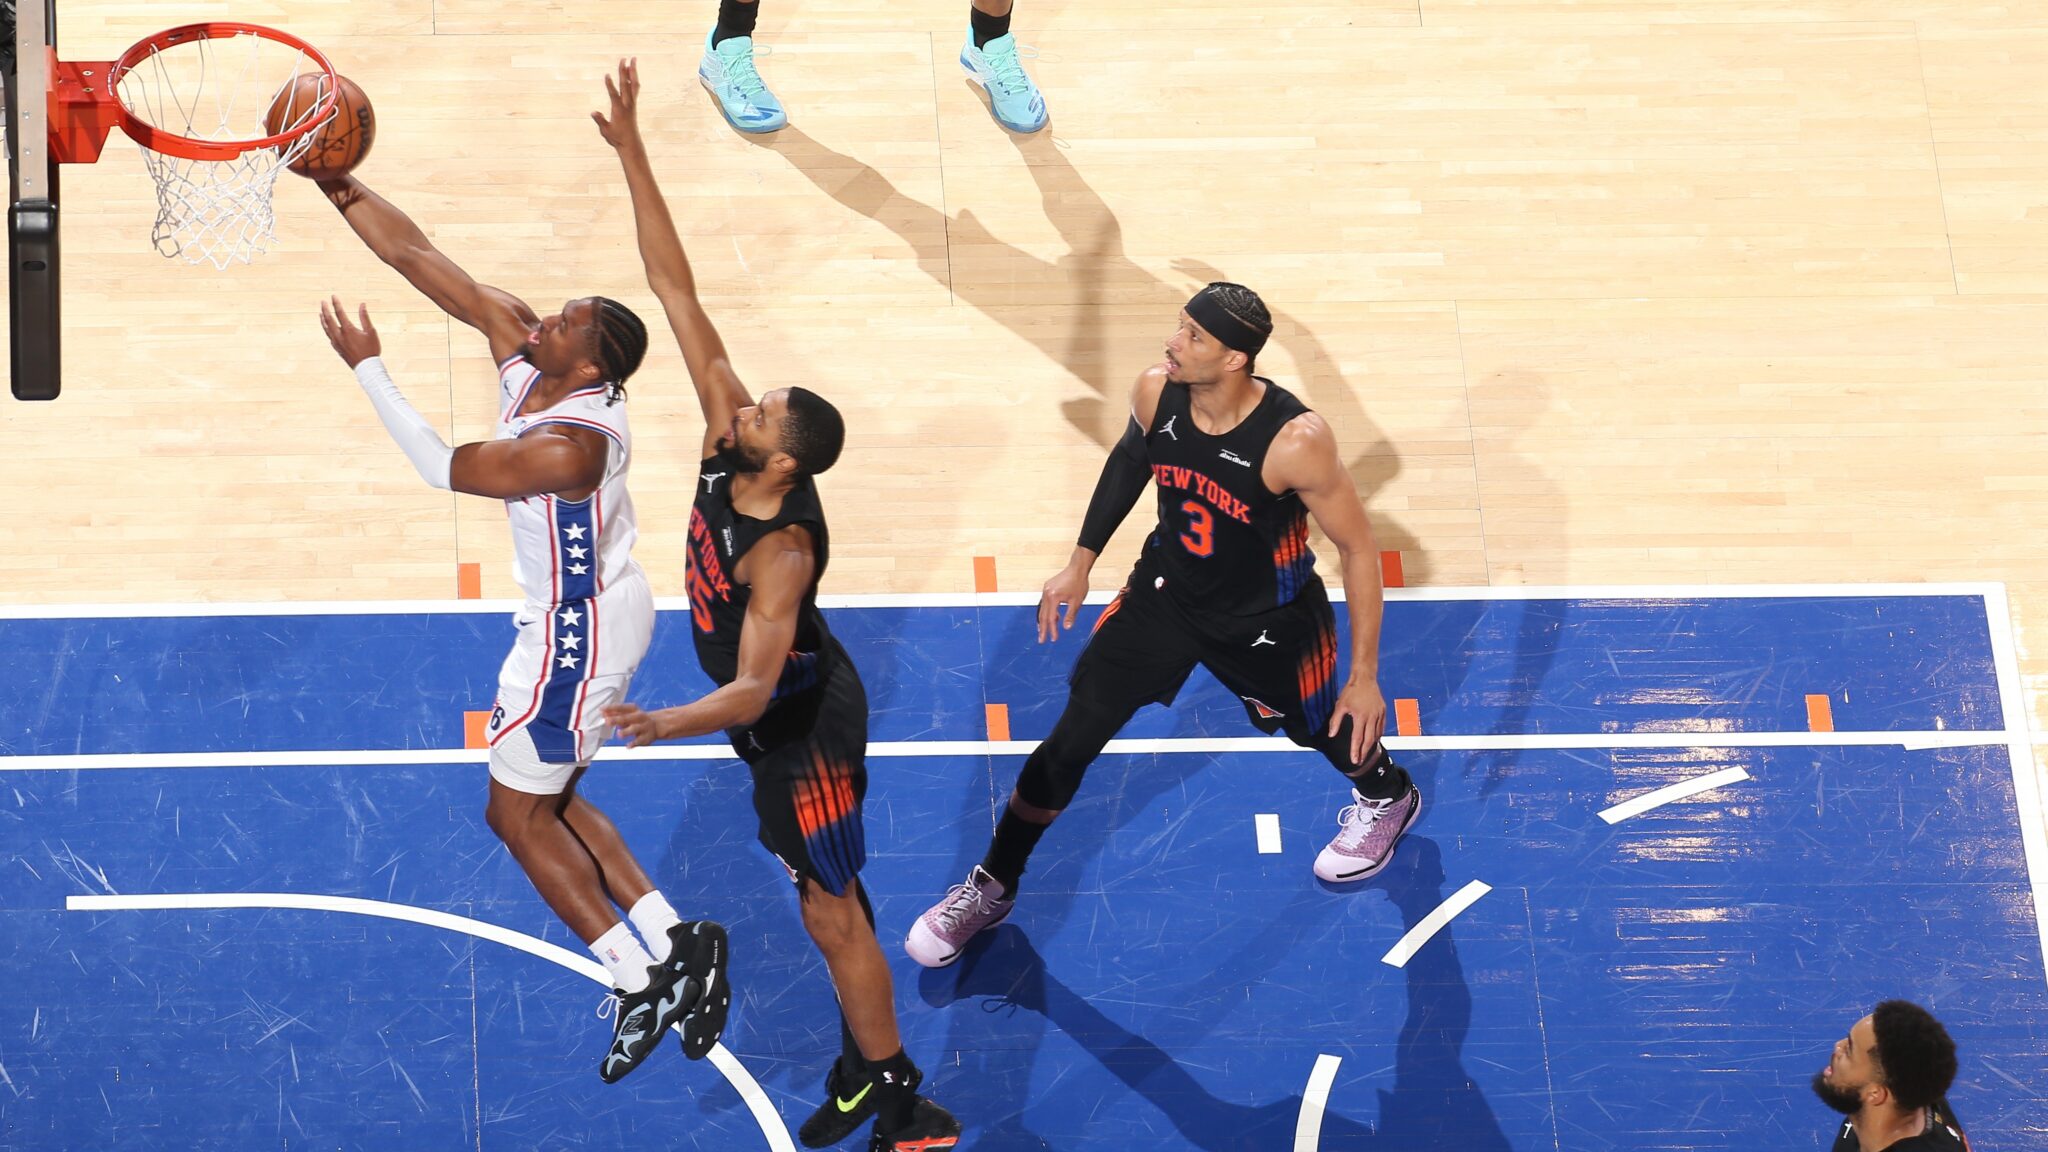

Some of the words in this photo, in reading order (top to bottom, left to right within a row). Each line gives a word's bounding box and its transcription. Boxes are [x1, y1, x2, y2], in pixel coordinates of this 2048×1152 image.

[1151, 464, 1193, 490] NEW
[1194, 471, 1250, 524] YORK
[1180, 500, 1214, 558] 3
[700, 529, 731, 602] YORK
[491, 707, 505, 730] 6
